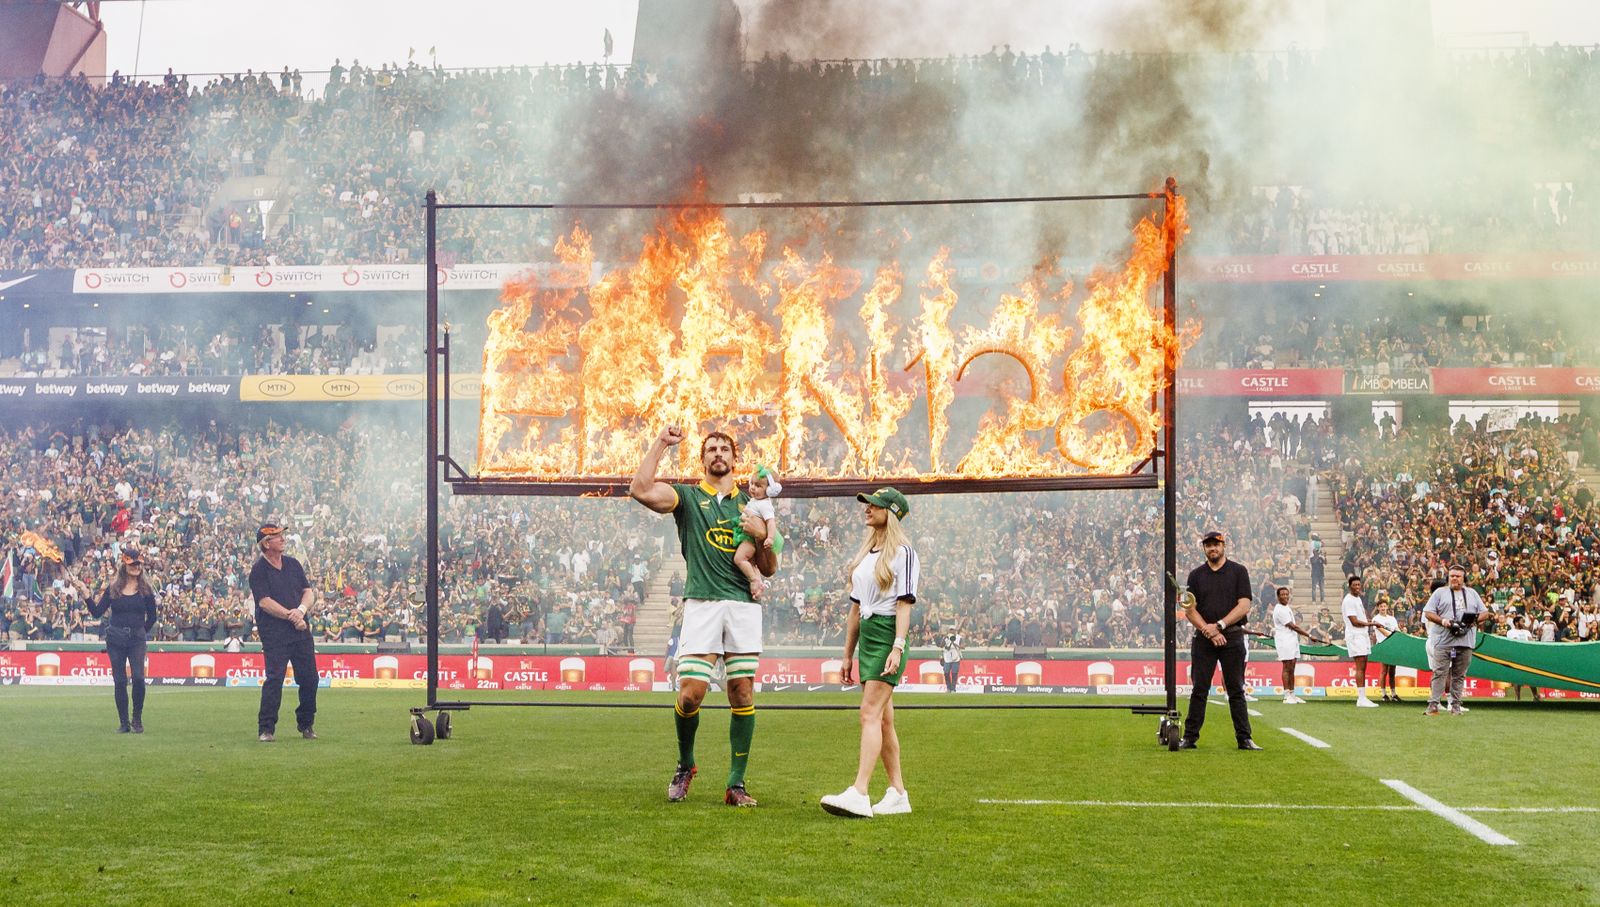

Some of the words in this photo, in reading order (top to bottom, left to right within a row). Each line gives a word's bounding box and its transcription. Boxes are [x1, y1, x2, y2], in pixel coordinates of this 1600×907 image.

[1291, 263, 1340, 273] CASTLE
[1377, 262, 1425, 273] CASTLE
[189, 272, 235, 283] SWIT
[1241, 377, 1289, 387] CASTLE
[1488, 376, 1537, 386] CASTLE
[0, 384, 27, 397] tway
[35, 383, 77, 396] betway
[86, 383, 128, 396] betway
[137, 383, 180, 395] betway
[188, 382, 231, 395] betway
[903, 334, 1150, 474] 128
[0, 667, 26, 677] STLE
[71, 667, 113, 677] CASTLE
[317, 670, 360, 679] CASTLE
[413, 670, 458, 681] CATLE
[504, 671, 548, 682] CASTLE
[162, 677, 186, 685] betway
[194, 677, 218, 685] betway
[761, 674, 807, 684] CASTLE
[958, 676, 1004, 686] CASTLE
[1126, 677, 1165, 687] CASTL
[1331, 678, 1379, 688] CASLE
[477, 680, 499, 689] 22m
